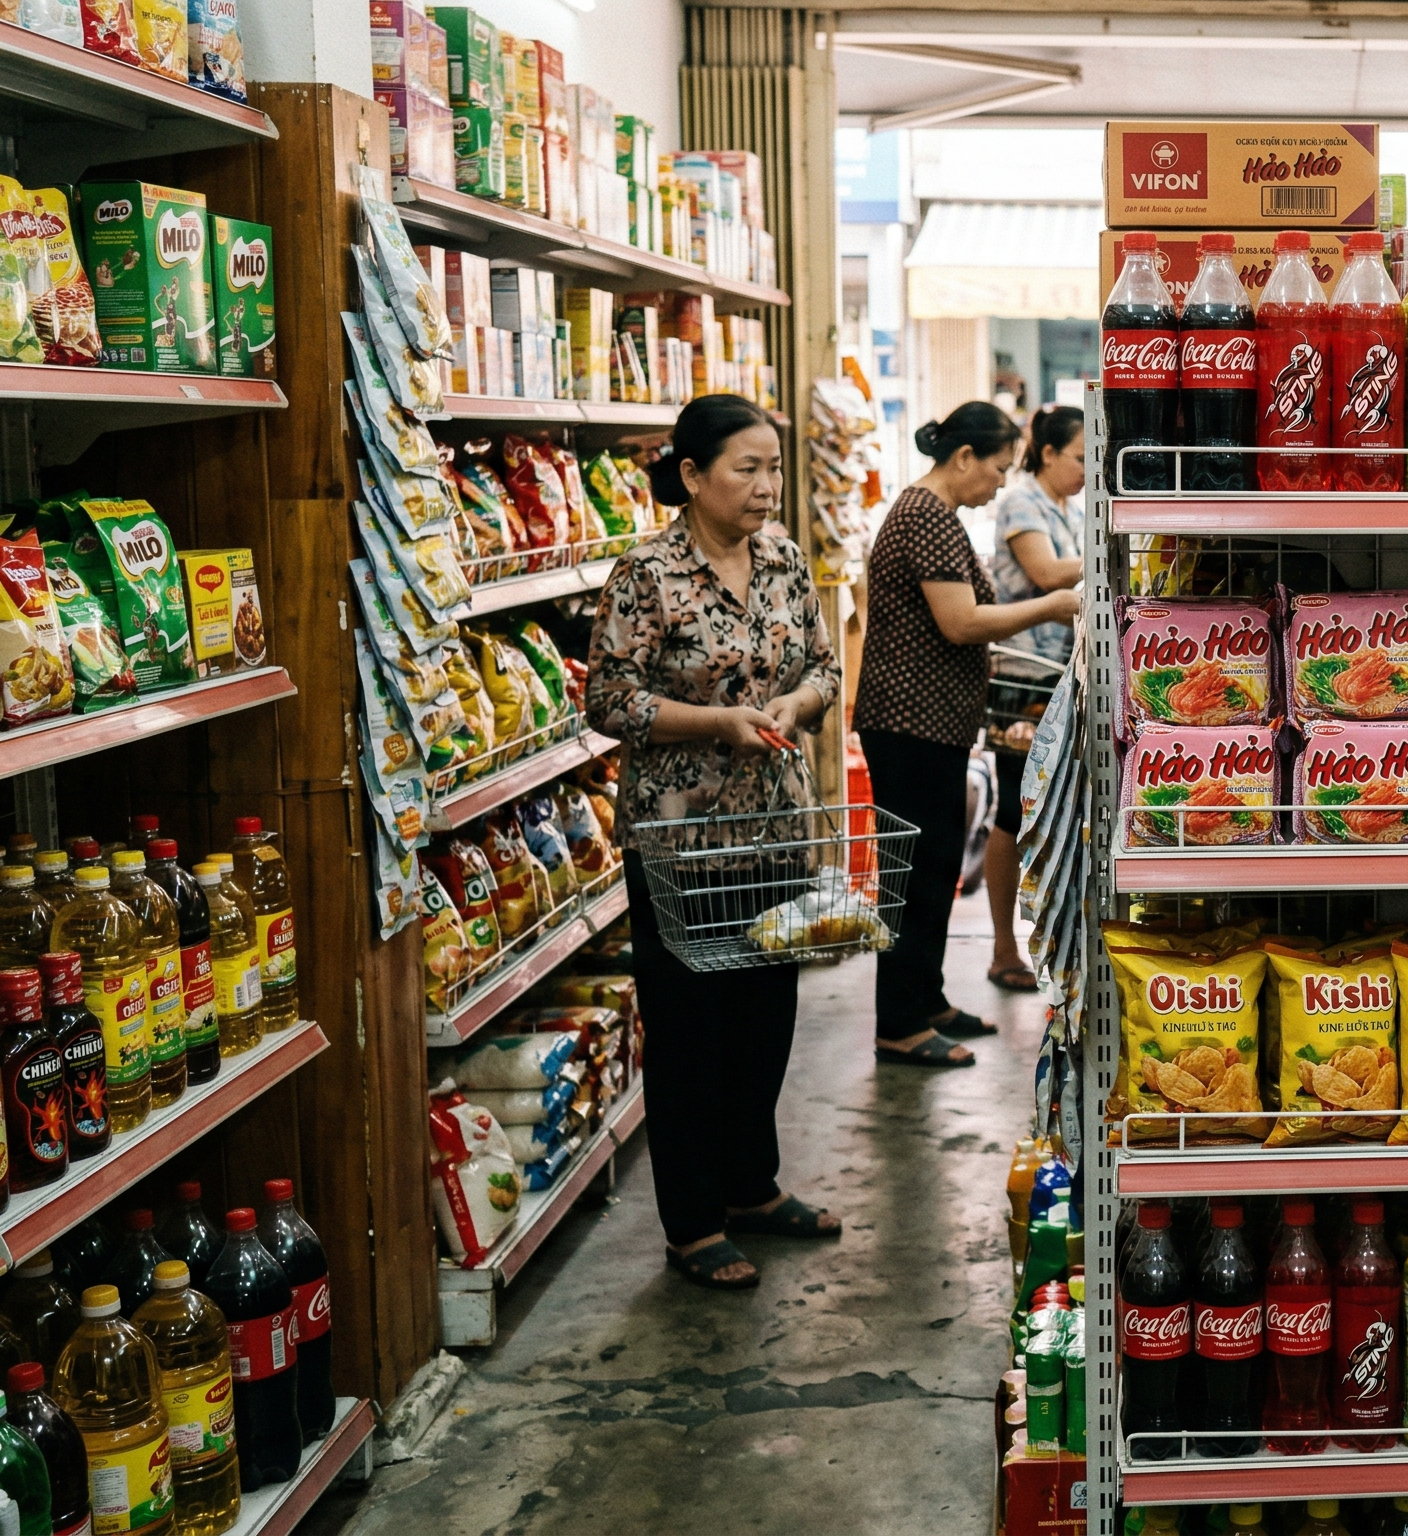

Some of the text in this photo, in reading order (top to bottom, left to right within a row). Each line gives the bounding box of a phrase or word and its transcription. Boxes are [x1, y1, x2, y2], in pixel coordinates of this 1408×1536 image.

[1131, 173, 1198, 190] VIFON
[1243, 148, 1341, 184] Hảo Hảo
[99, 206, 129, 218] MILO
[162, 228, 200, 253] MILO
[233, 254, 265, 278] MILO
[1104, 336, 1178, 371] Coca-Cola
[1180, 336, 1256, 371] Coca-Cola
[1278, 349, 1322, 417] STING
[1355, 349, 1398, 417] STING
[120, 536, 163, 566] MILO
[1132, 616, 1270, 672] Hảo Hảo
[1296, 614, 1362, 661] Hảo
[1138, 735, 1273, 787] Hảo Hảo
[1307, 742, 1375, 787] Hảo
[1150, 975, 1242, 1013] Oishi
[1304, 975, 1393, 1013] Kishi
[1124, 1304, 1191, 1341] Coca-Cola
[1197, 1305, 1263, 1340] Coca-Cola
[1266, 1302, 1331, 1336] Coca-Cola
